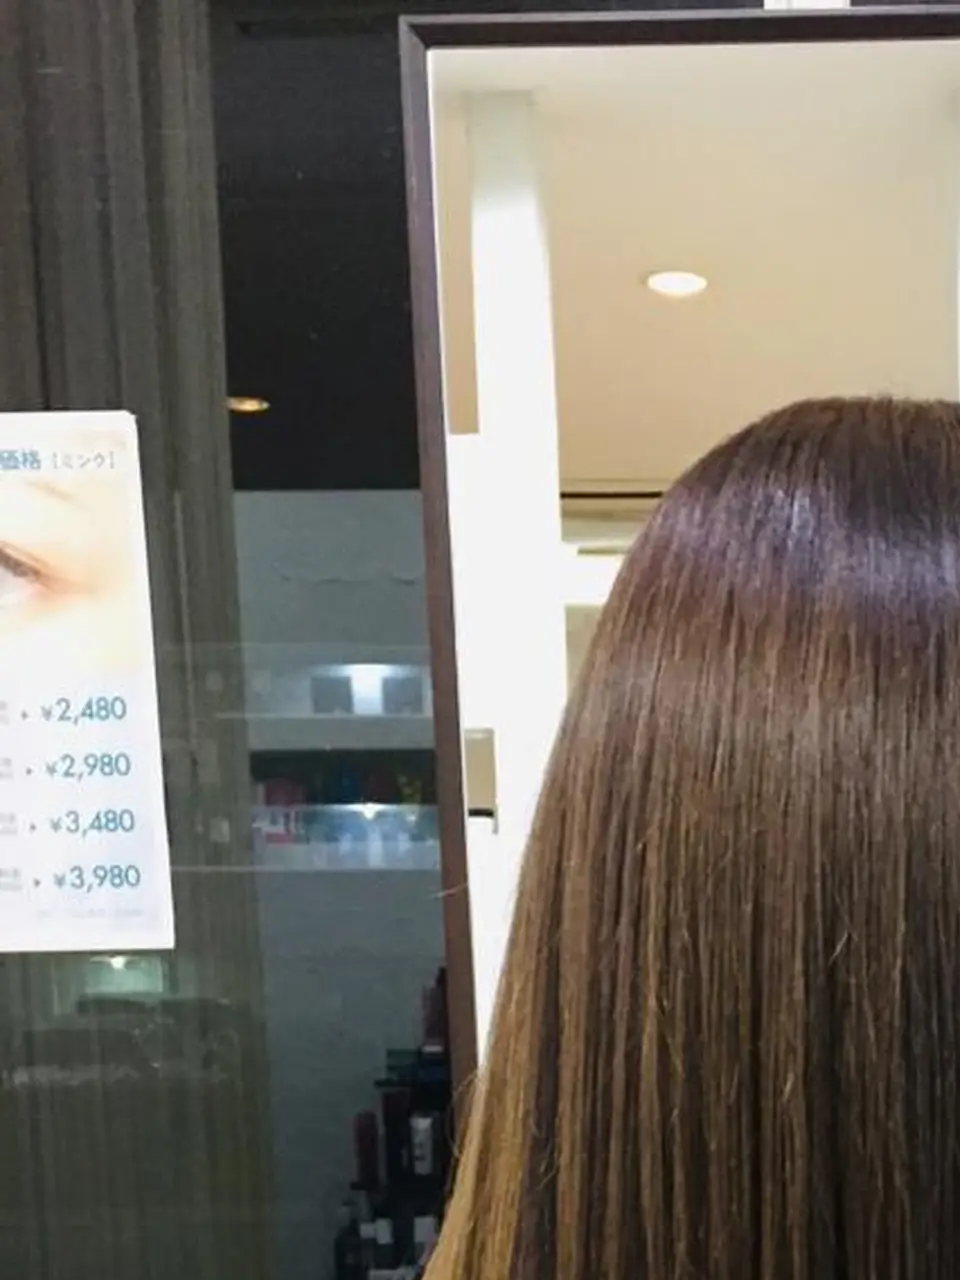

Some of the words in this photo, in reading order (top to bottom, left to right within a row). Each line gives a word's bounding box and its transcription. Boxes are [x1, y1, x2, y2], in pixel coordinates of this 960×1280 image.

[41, 696, 127, 726] ¥2,480
[45, 752, 131, 782] ¥2,980
[50, 808, 135, 837] ¥3,480
[54, 864, 141, 893] ¥3,980
